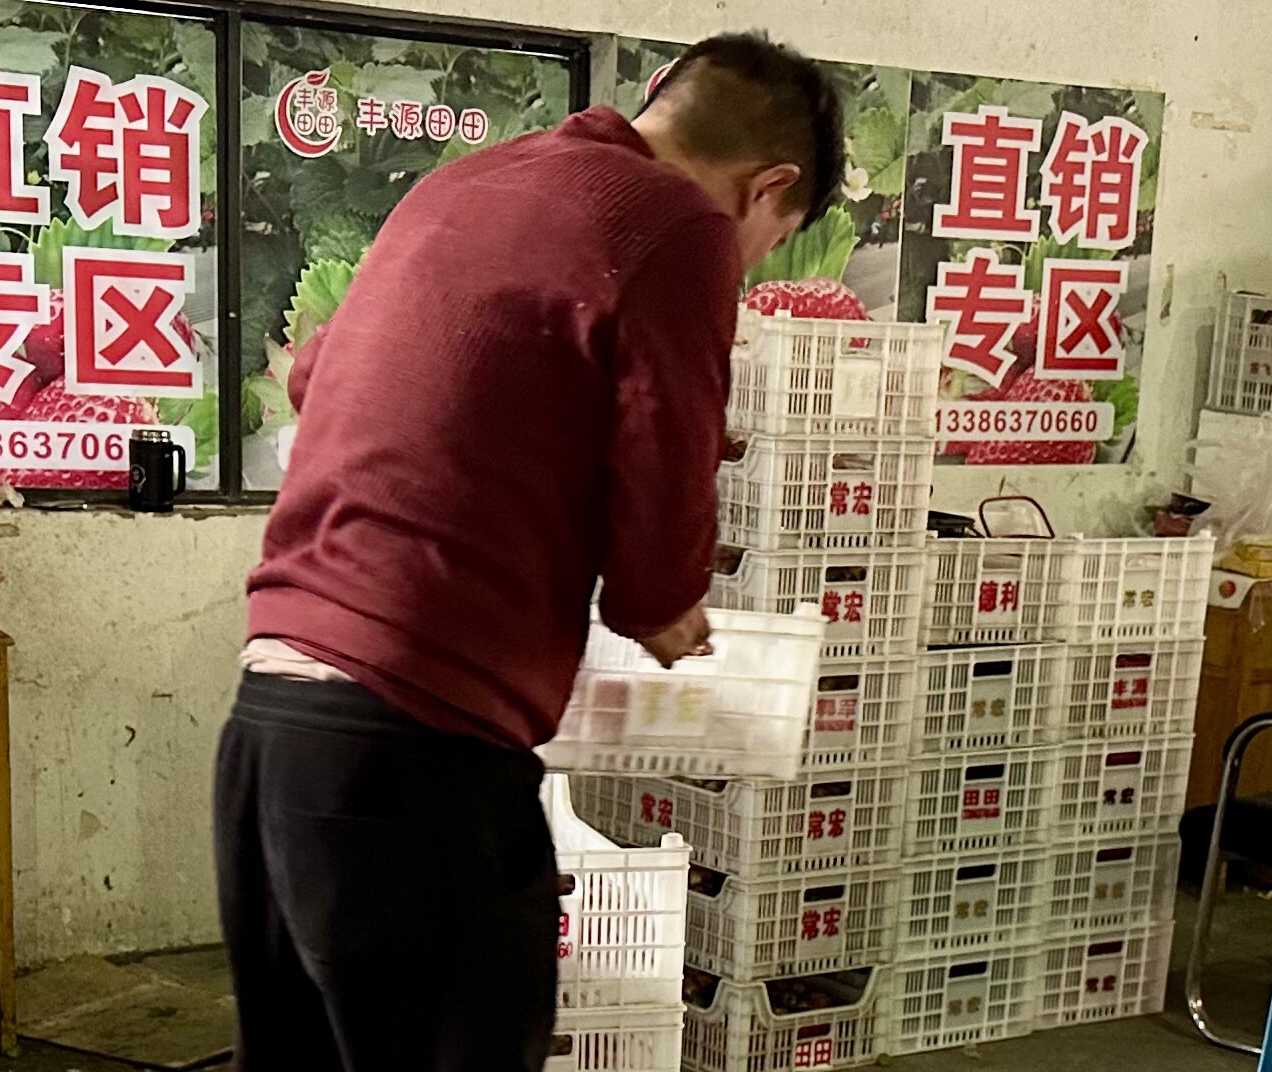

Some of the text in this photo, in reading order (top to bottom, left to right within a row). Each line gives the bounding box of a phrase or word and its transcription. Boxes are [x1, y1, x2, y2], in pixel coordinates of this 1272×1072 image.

[358, 98, 487, 142] 丰源田田
[937, 110, 1142, 245] 直销
[930, 252, 1123, 378] 专区
[935, 409, 1097, 433] 13386370660
[829, 481, 872, 517] 常宏
[978, 580, 1020, 612] 德利
[807, 808, 847, 840] 常宏
[801, 907, 842, 941] 常宏
